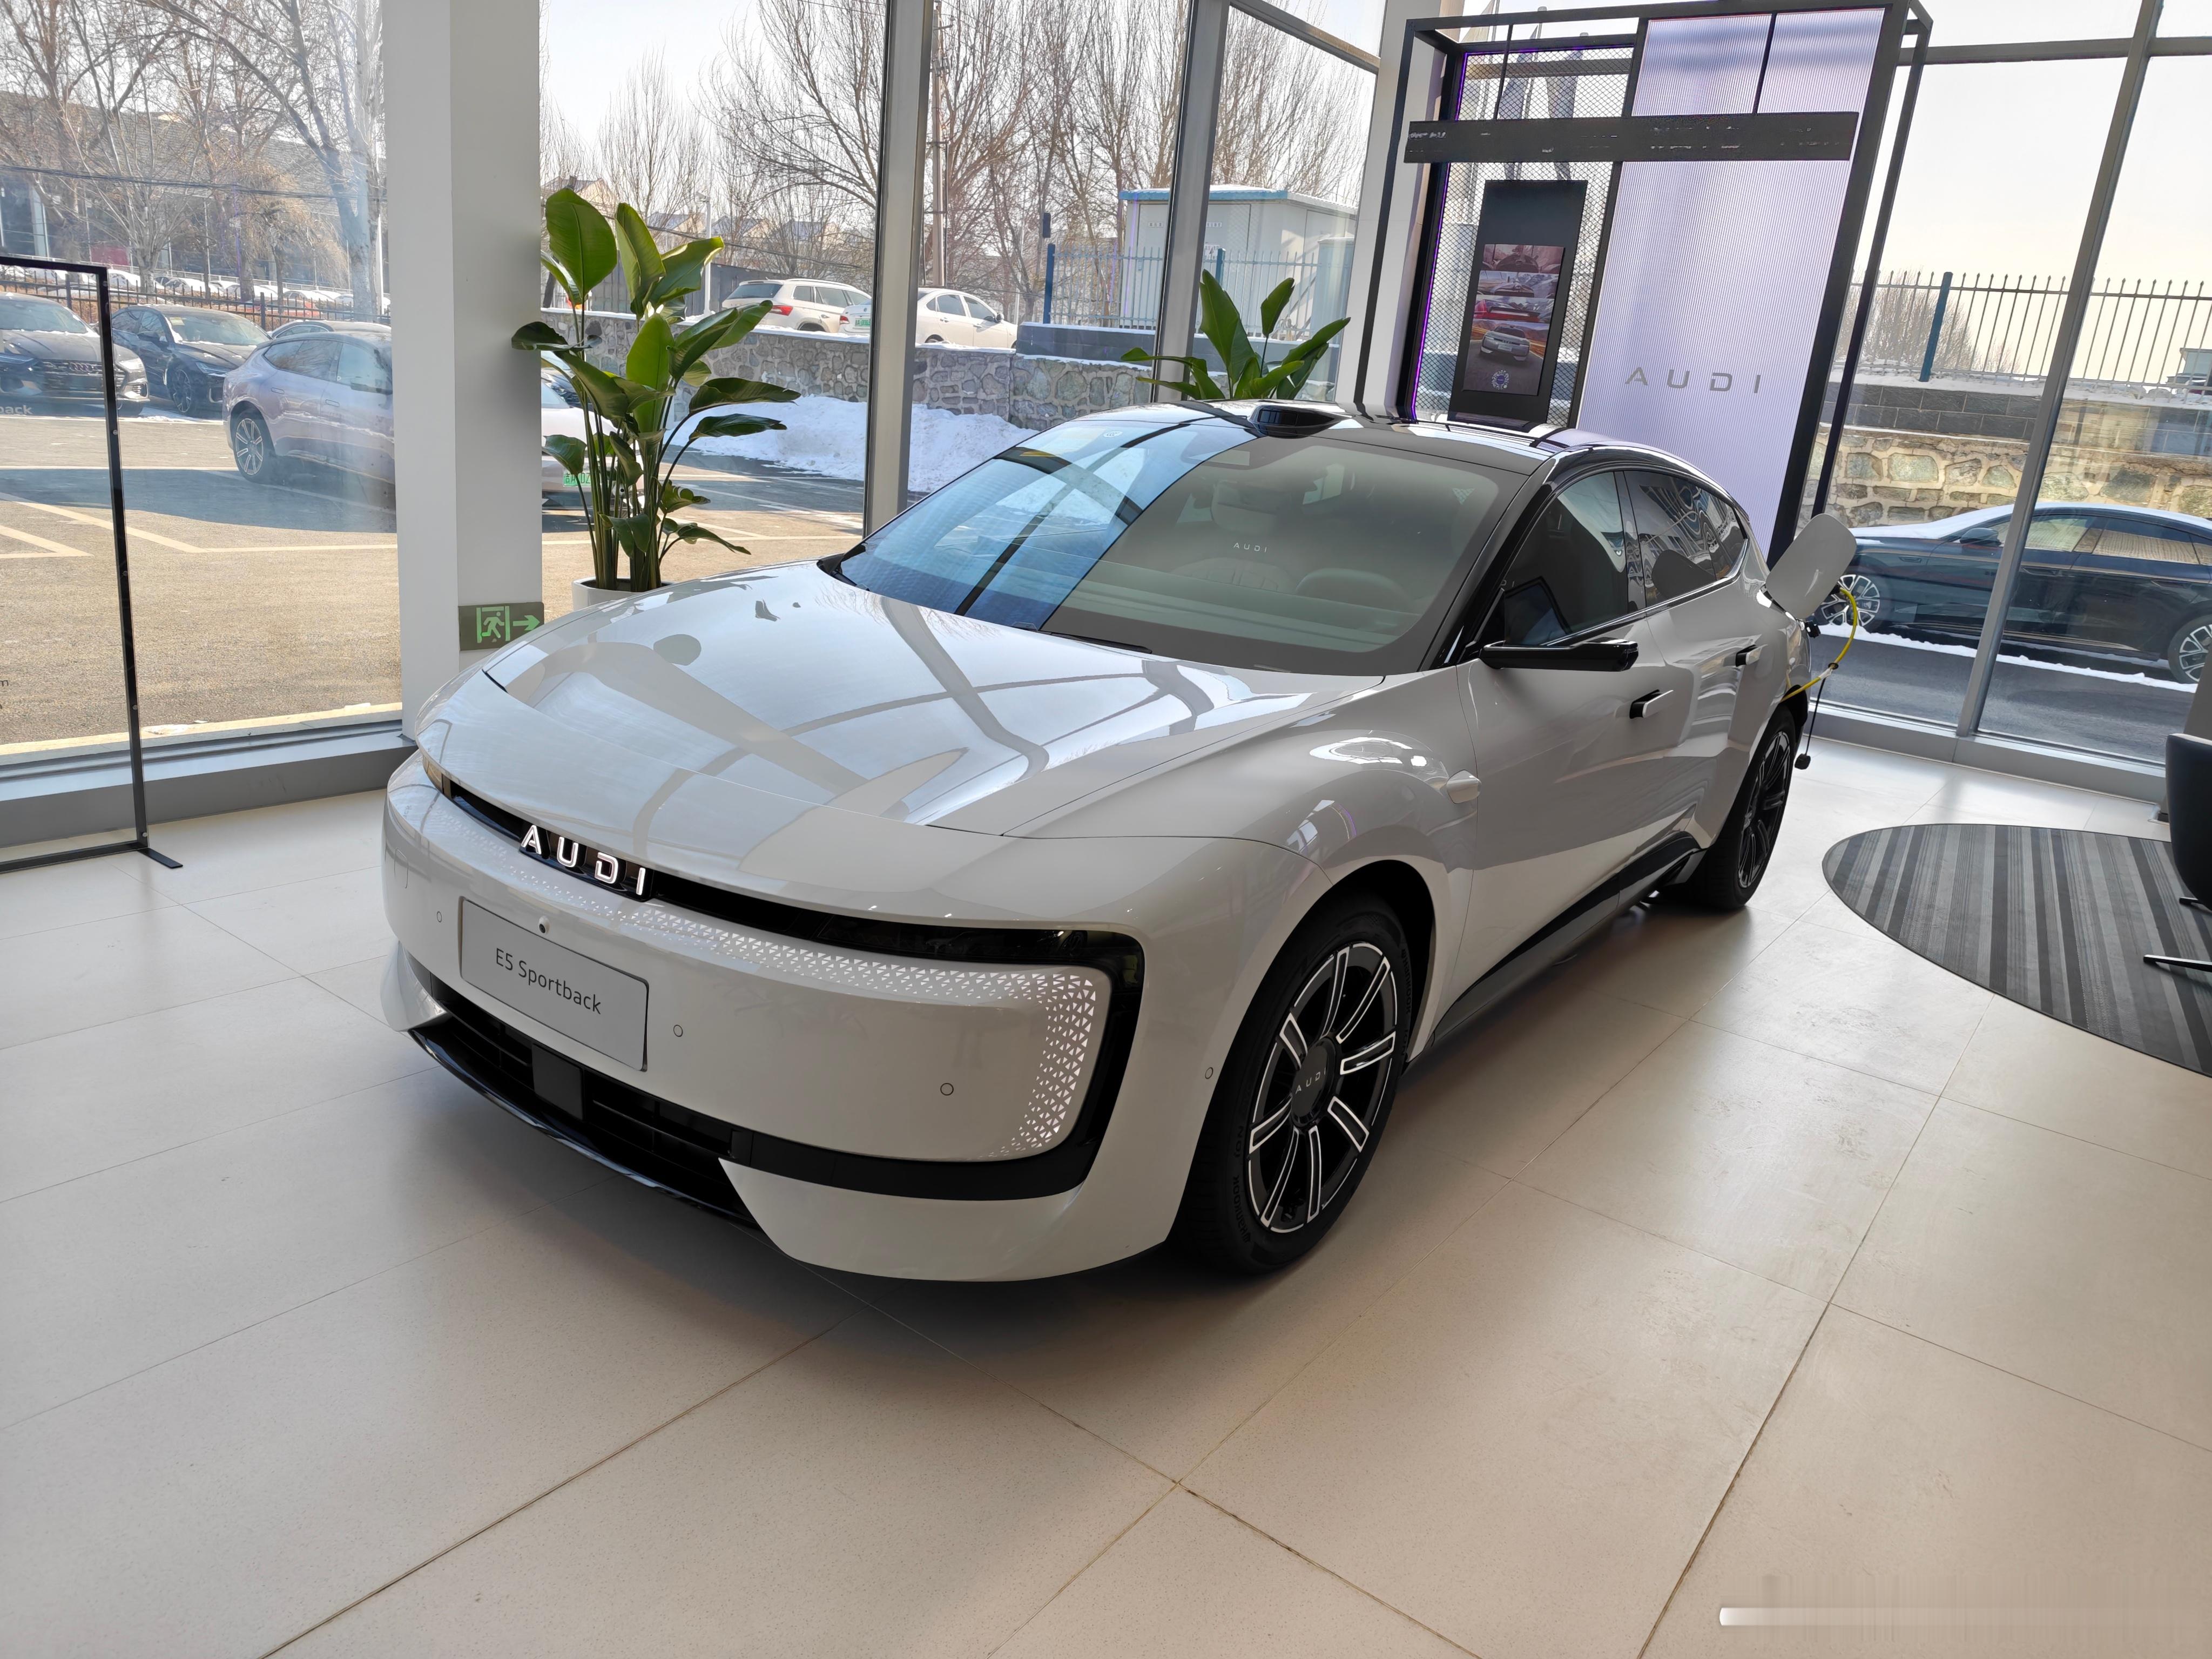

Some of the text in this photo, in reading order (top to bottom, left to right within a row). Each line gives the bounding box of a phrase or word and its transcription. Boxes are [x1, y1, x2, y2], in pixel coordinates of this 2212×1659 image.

[1624, 367, 1761, 394] AUDI
[1233, 542, 1267, 553] AUDI
[521, 825, 645, 895] AUDI
[496, 948, 601, 1015] E5 Sportback
[1296, 1067, 1326, 1094] AUDI
